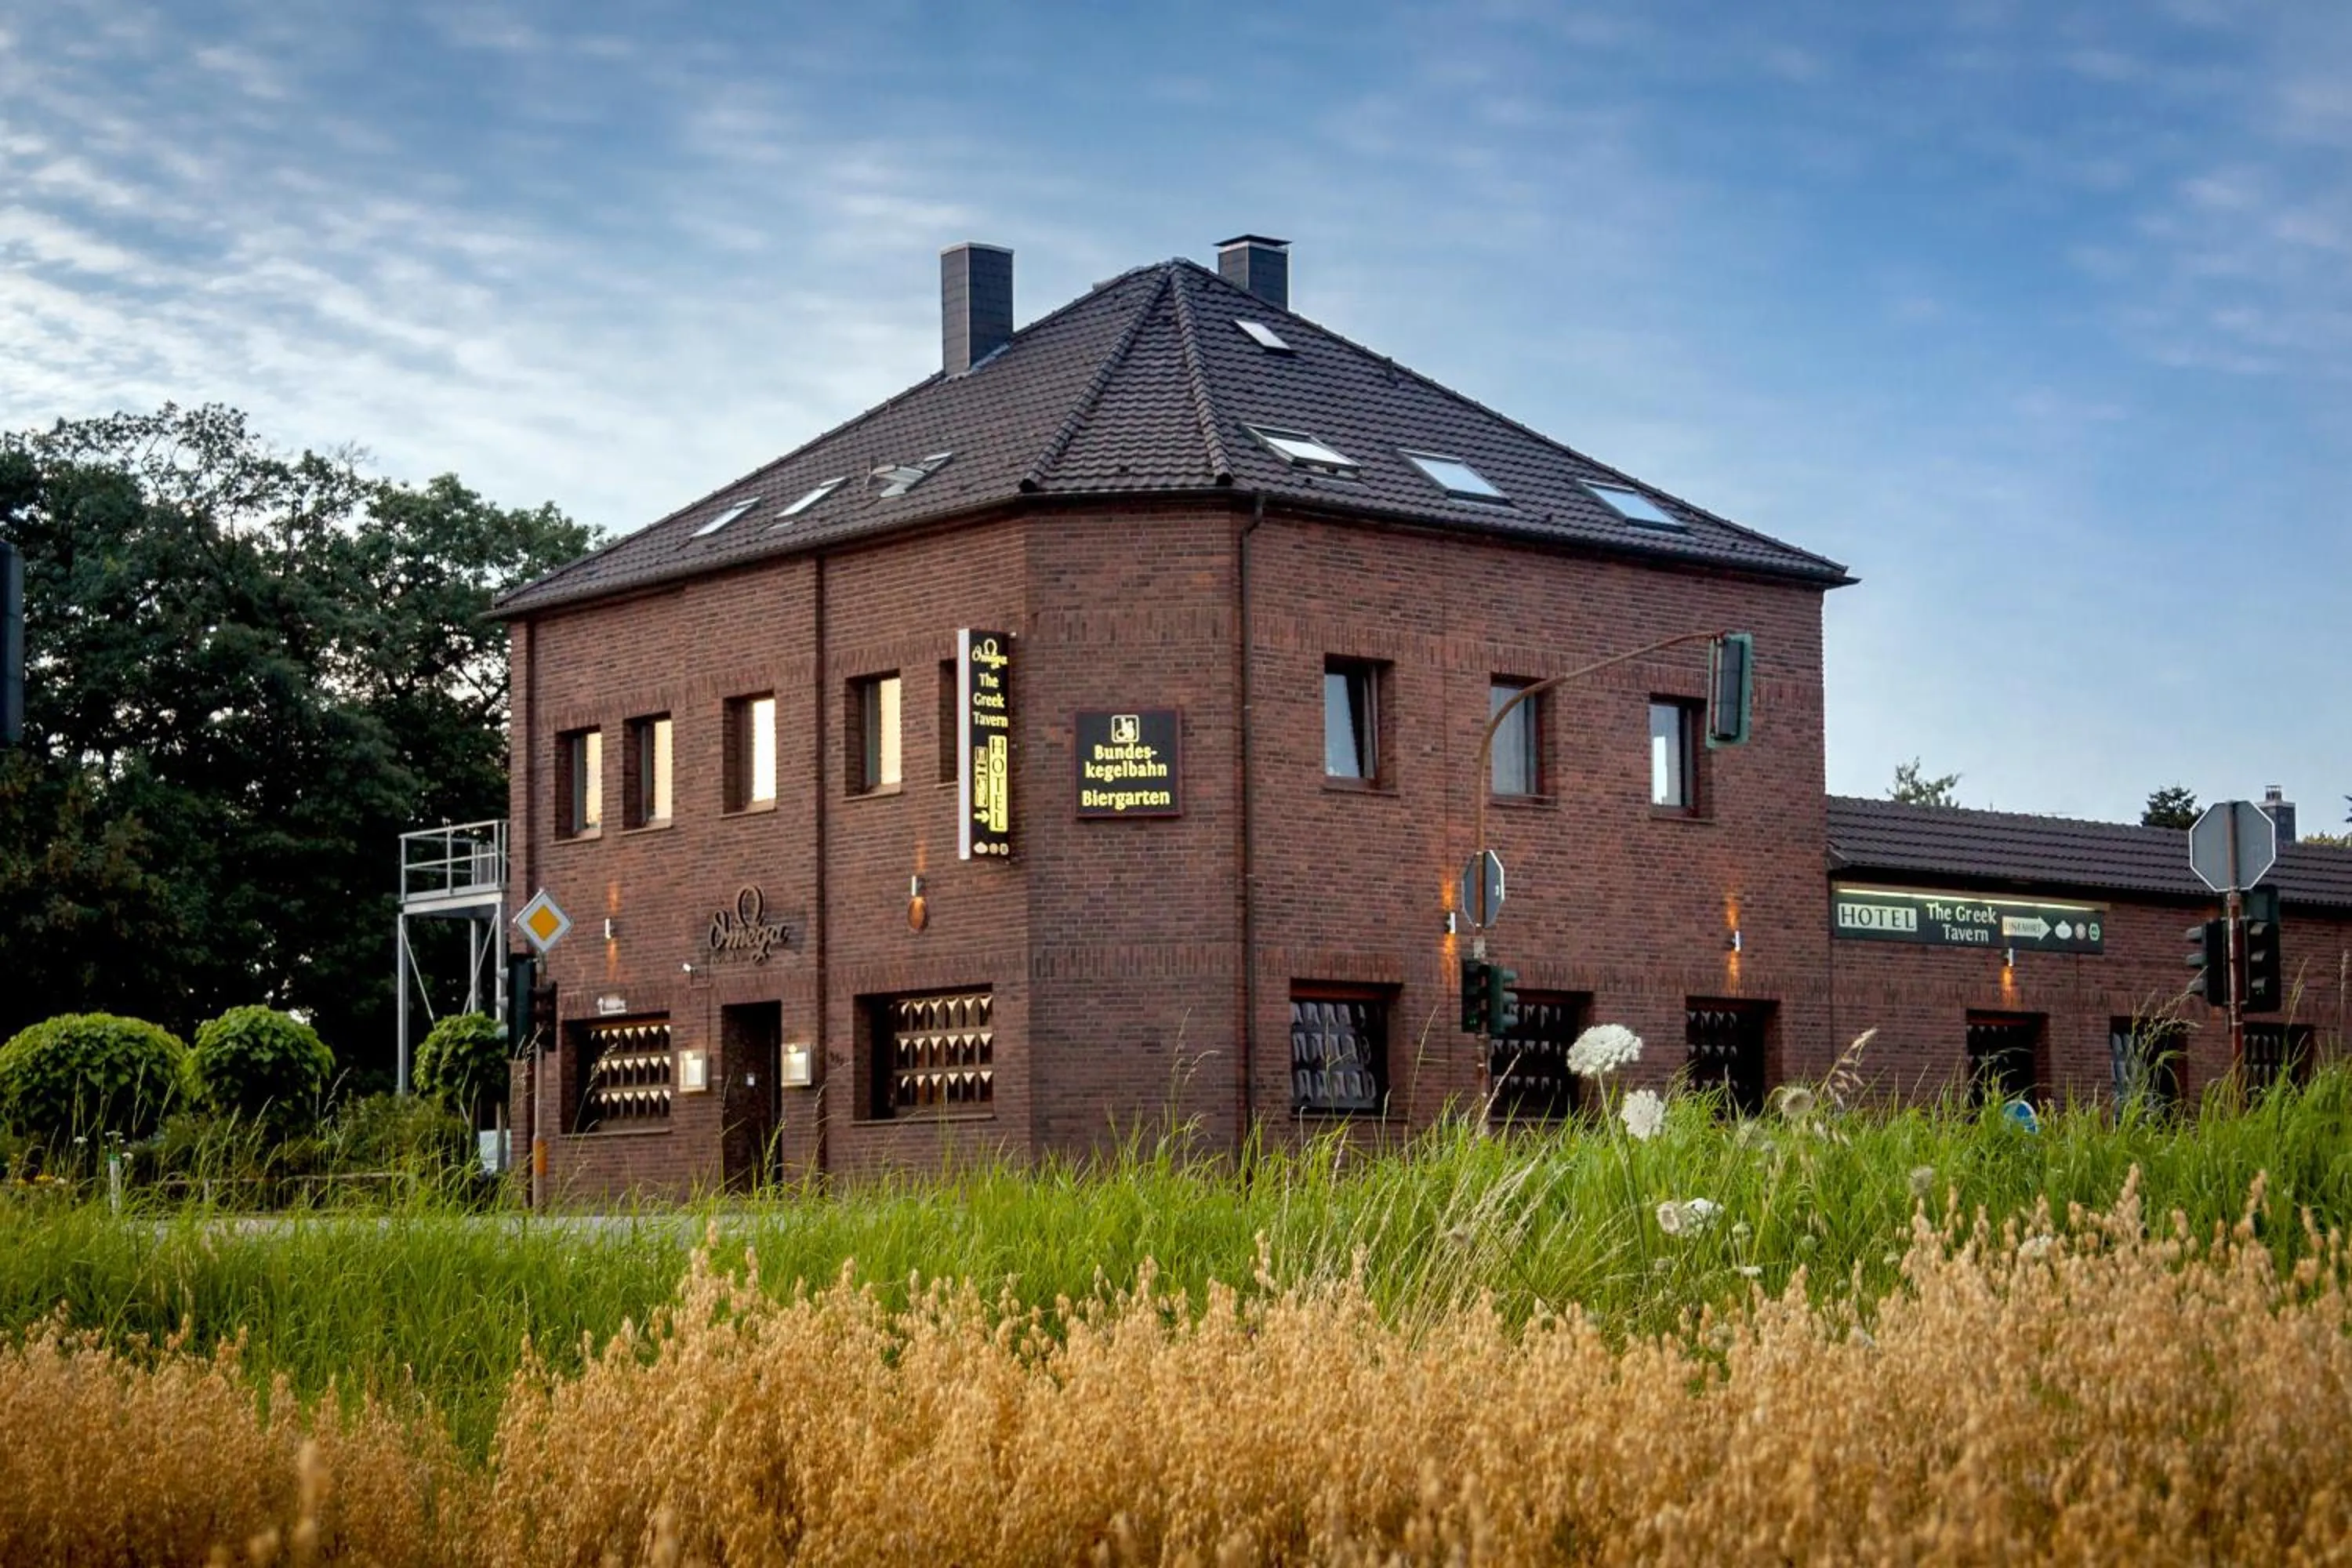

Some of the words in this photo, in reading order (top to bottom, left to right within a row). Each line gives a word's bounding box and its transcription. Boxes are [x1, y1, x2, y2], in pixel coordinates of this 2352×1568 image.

[978, 672, 1000, 688] The
[973, 692, 1005, 709] Greek
[972, 711, 1009, 728] Tavern
[1094, 742, 1158, 760] Bundes-
[1085, 760, 1167, 782] kegelbahn
[992, 738, 1004, 828] HOTEL
[1082, 789, 1171, 811] Biergarten
[1841, 906, 1915, 929] HOTEL
[1926, 902, 1952, 920] The
[1955, 906, 1997, 924] Greek
[1942, 923, 1989, 942] Tavern
